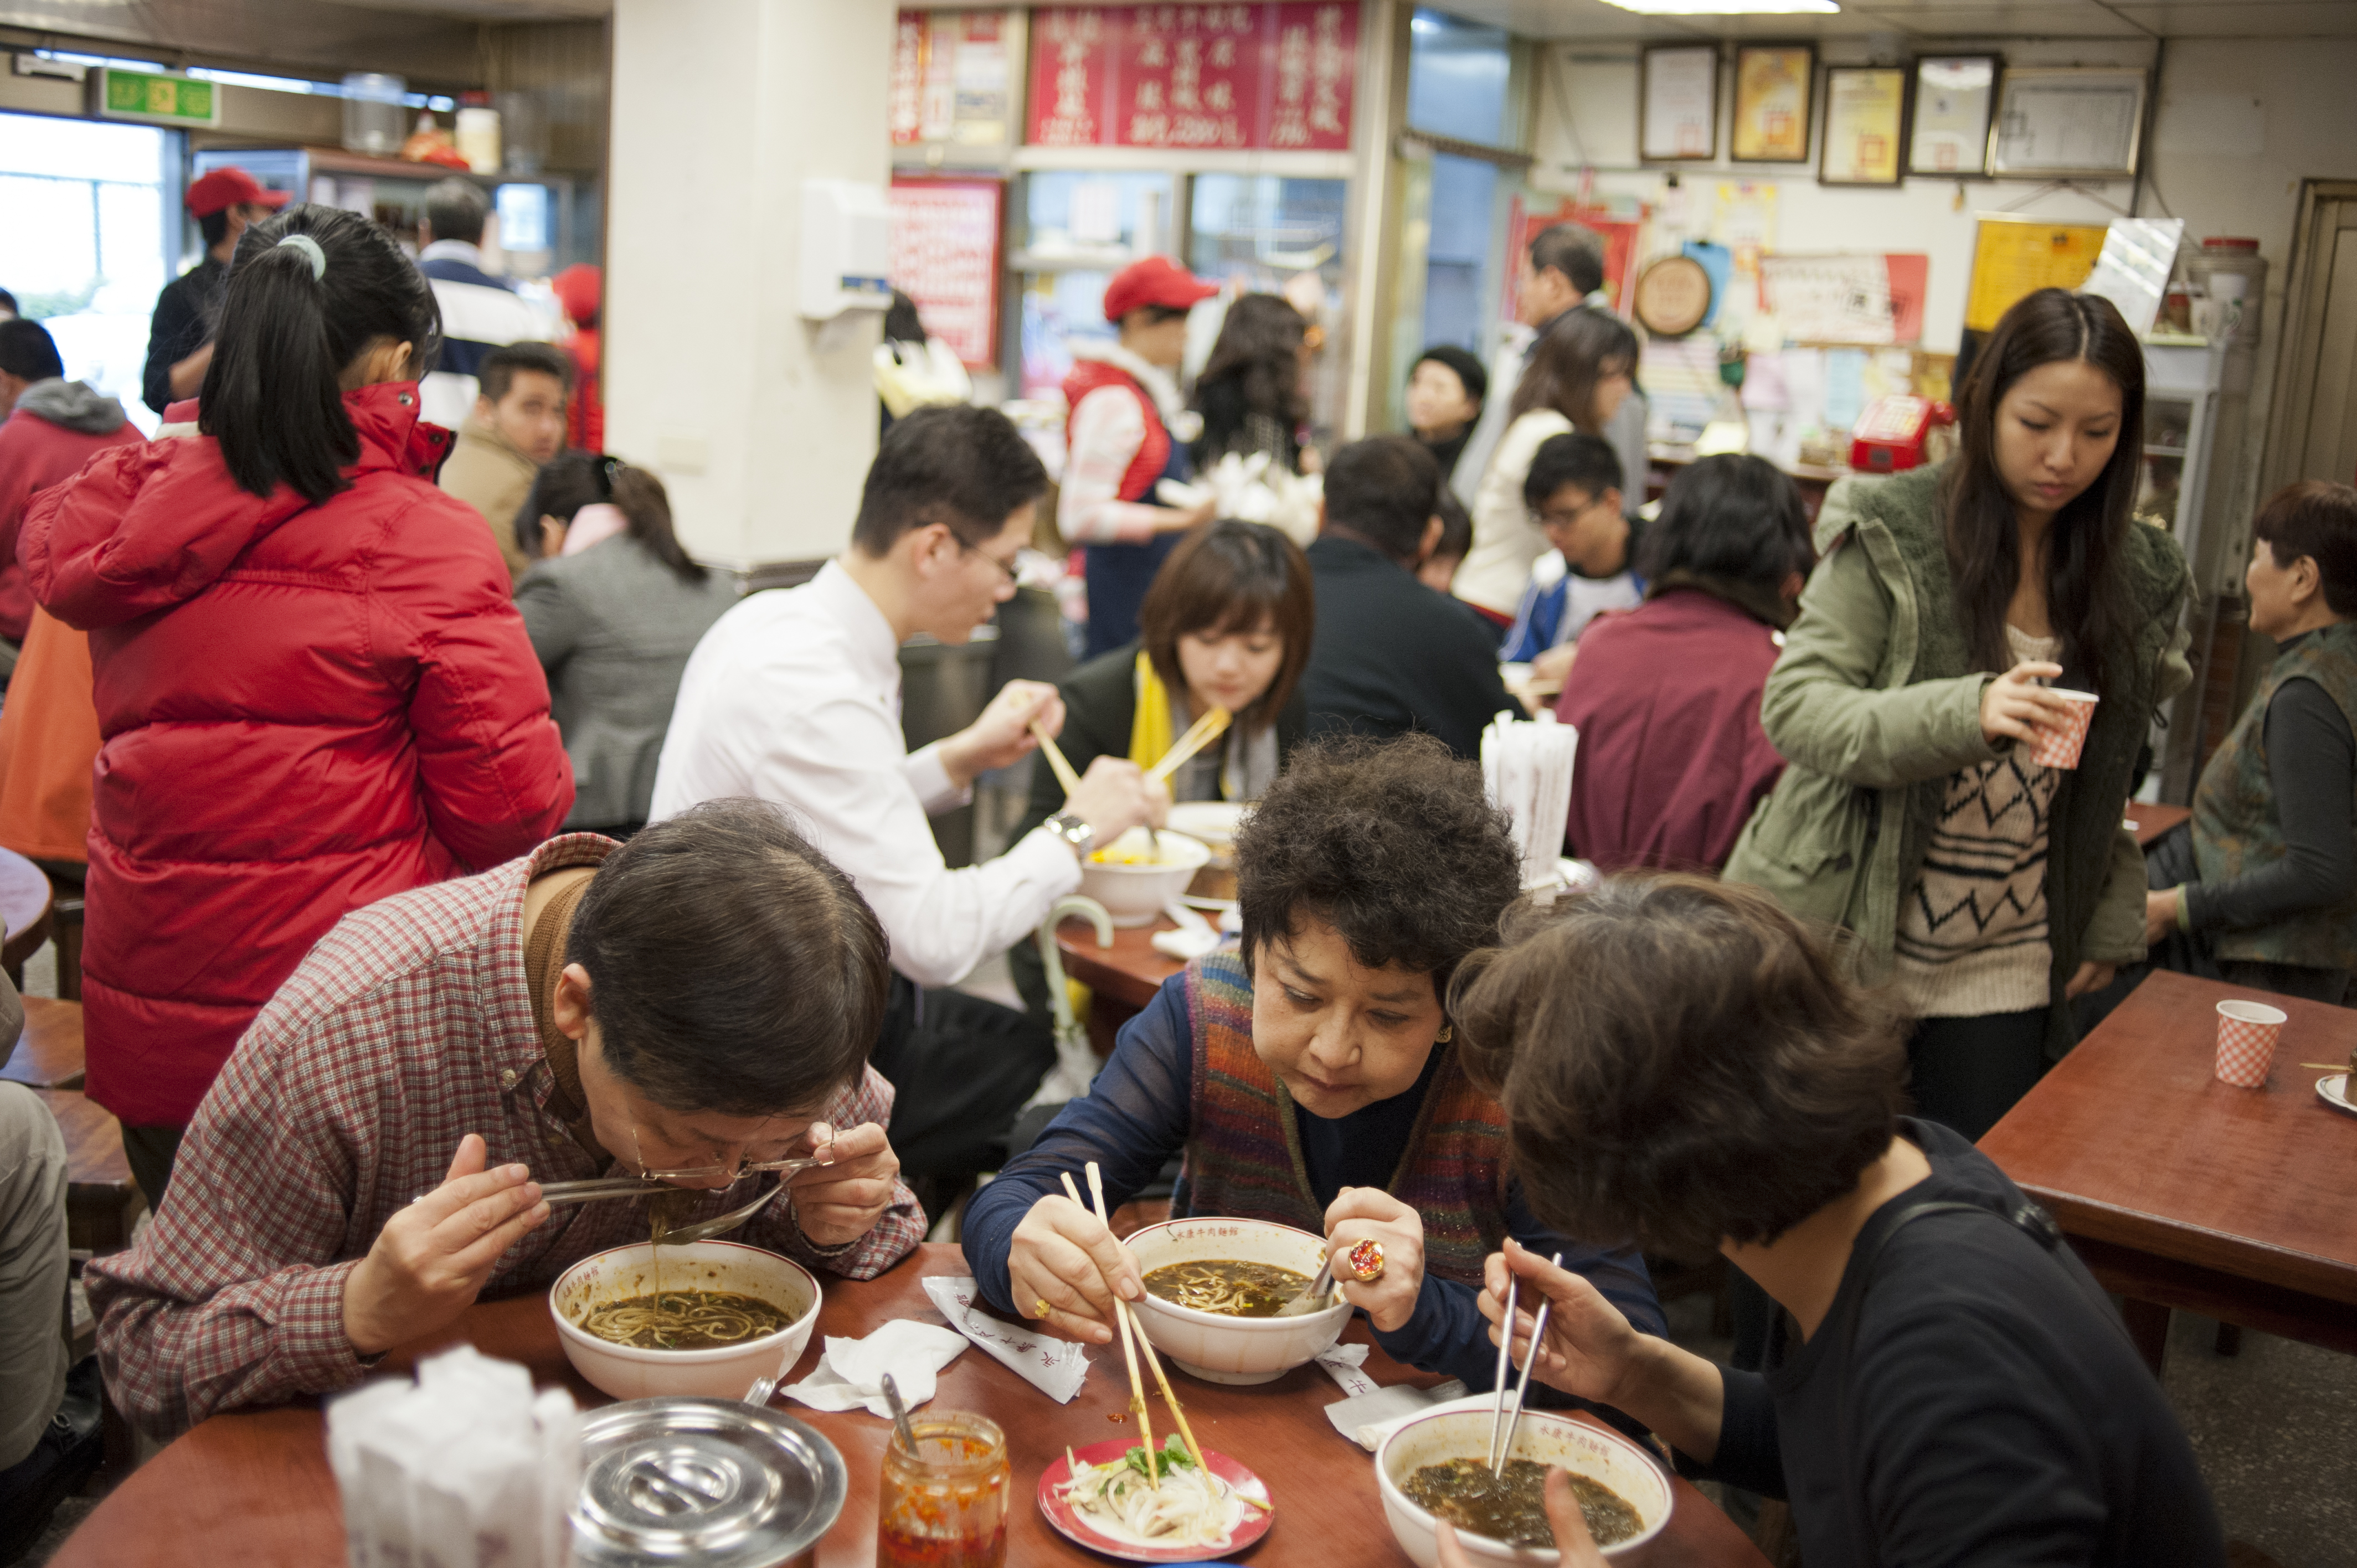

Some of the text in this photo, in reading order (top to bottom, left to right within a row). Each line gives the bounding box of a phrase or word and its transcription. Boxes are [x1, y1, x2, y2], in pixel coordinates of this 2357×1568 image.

[1177, 1226, 1238, 1239] 永康牛肉麵館
[562, 1266, 599, 1300] 永康牛肉麵館
[1539, 1423, 1611, 1457] 永康牛肉麵館
